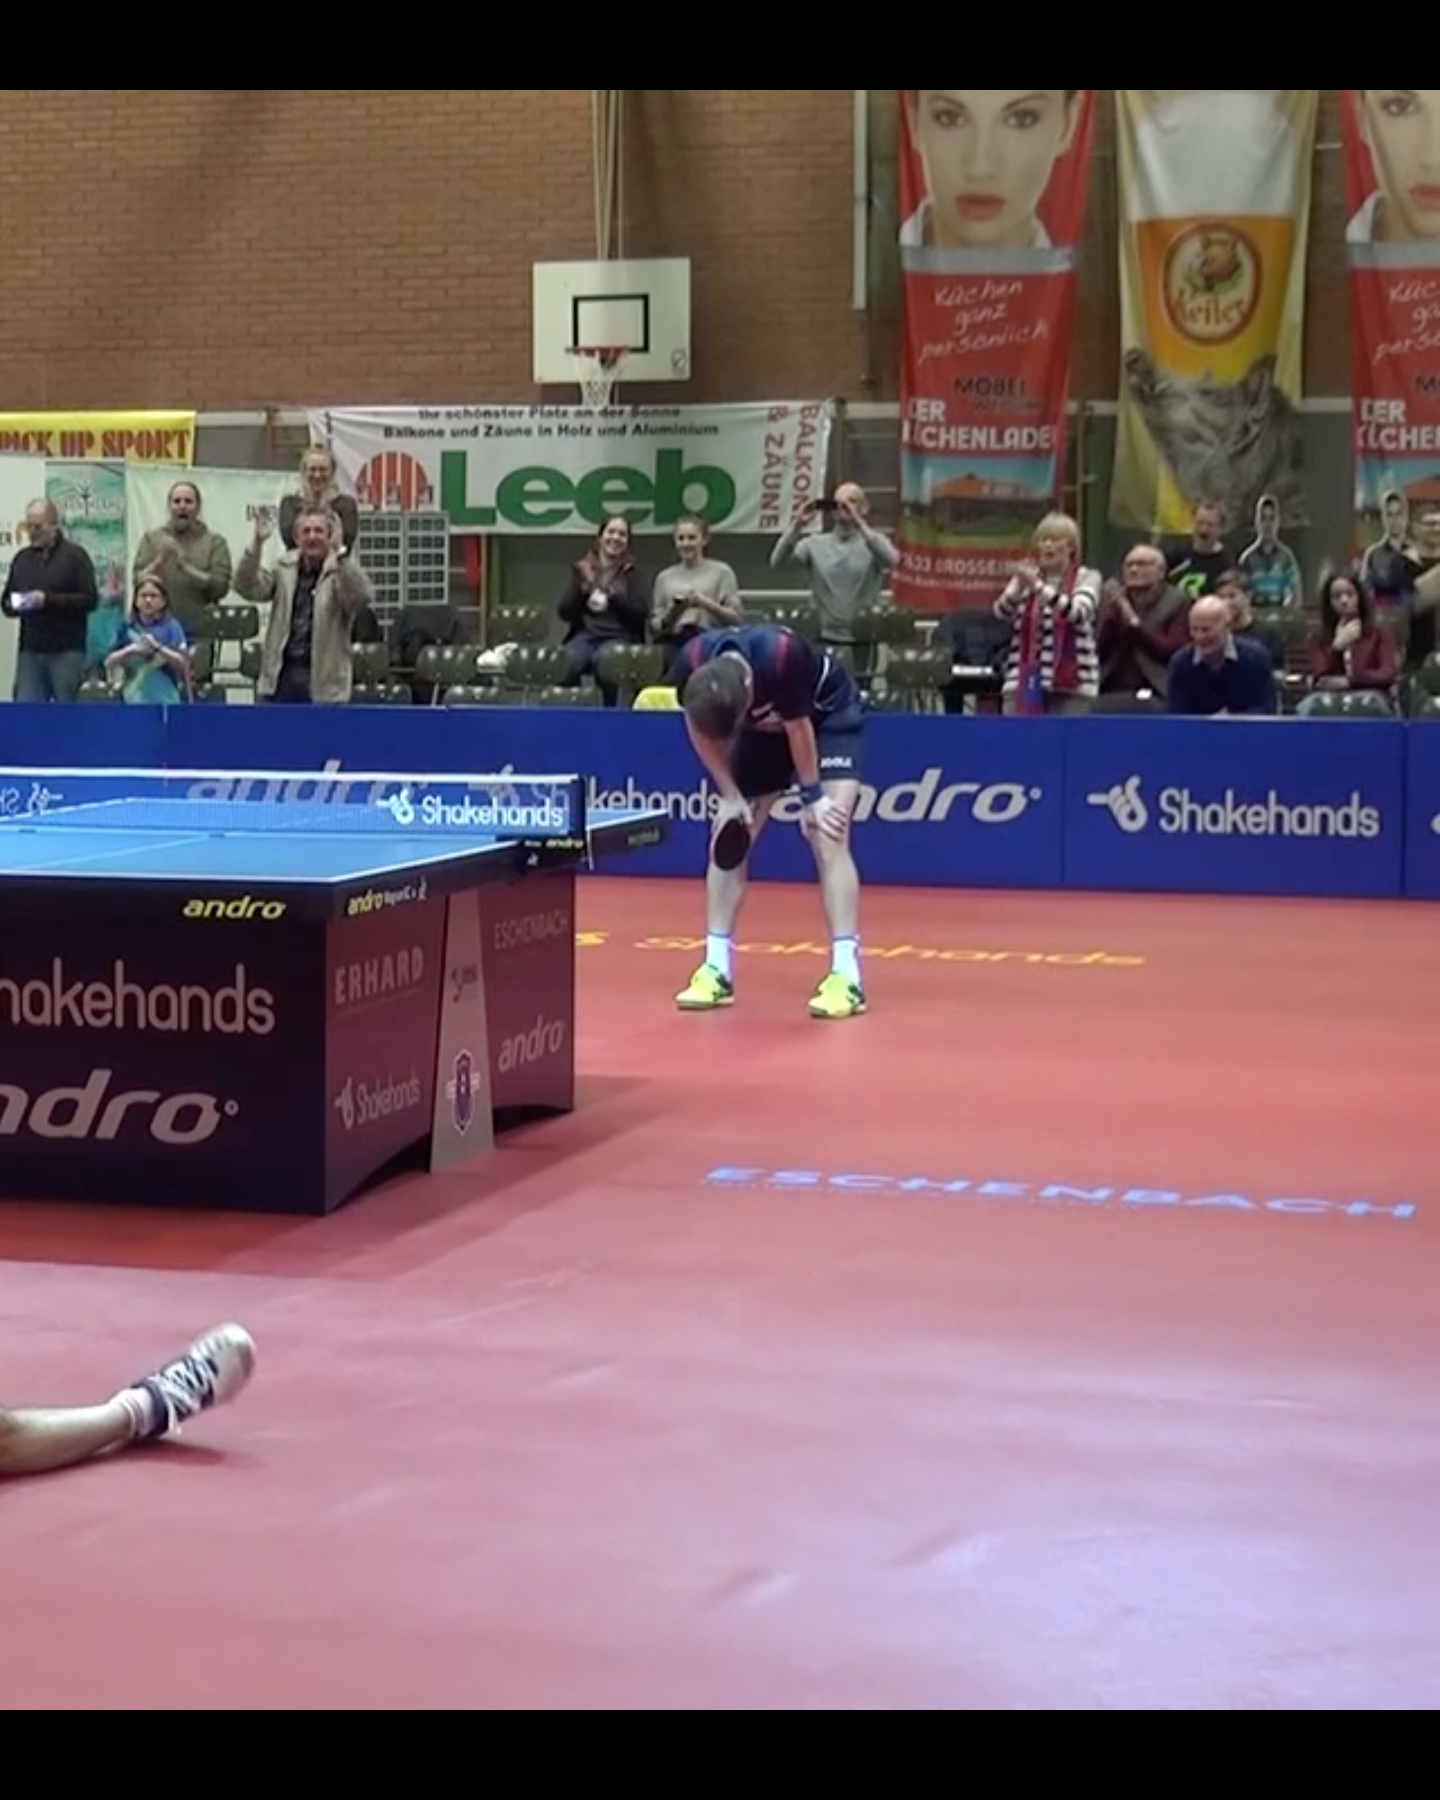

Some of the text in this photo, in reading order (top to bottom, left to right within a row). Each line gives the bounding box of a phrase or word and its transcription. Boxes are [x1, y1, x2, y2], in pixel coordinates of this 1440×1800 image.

[954, 303, 1007, 336] ganz
[61, 429, 96, 458] UP
[100, 427, 191, 460] SPORT
[383, 422, 720, 439] Balkone und Zäune in Holz und Aluminium
[902, 420, 1057, 450] CHENLADE
[789, 404, 820, 524] BALKON
[440, 448, 737, 528] Leeb
[421, 795, 565, 827] Shakehands
[1160, 788, 1381, 838] Shakehands
[182, 894, 287, 920] andro
[347, 888, 383, 916] andro
[494, 909, 569, 951] ESCHENBACH
[334, 945, 425, 1005] ERHARD
[498, 1014, 564, 1073] andro
[705, 1165, 1418, 1219] ESCHENBACH
